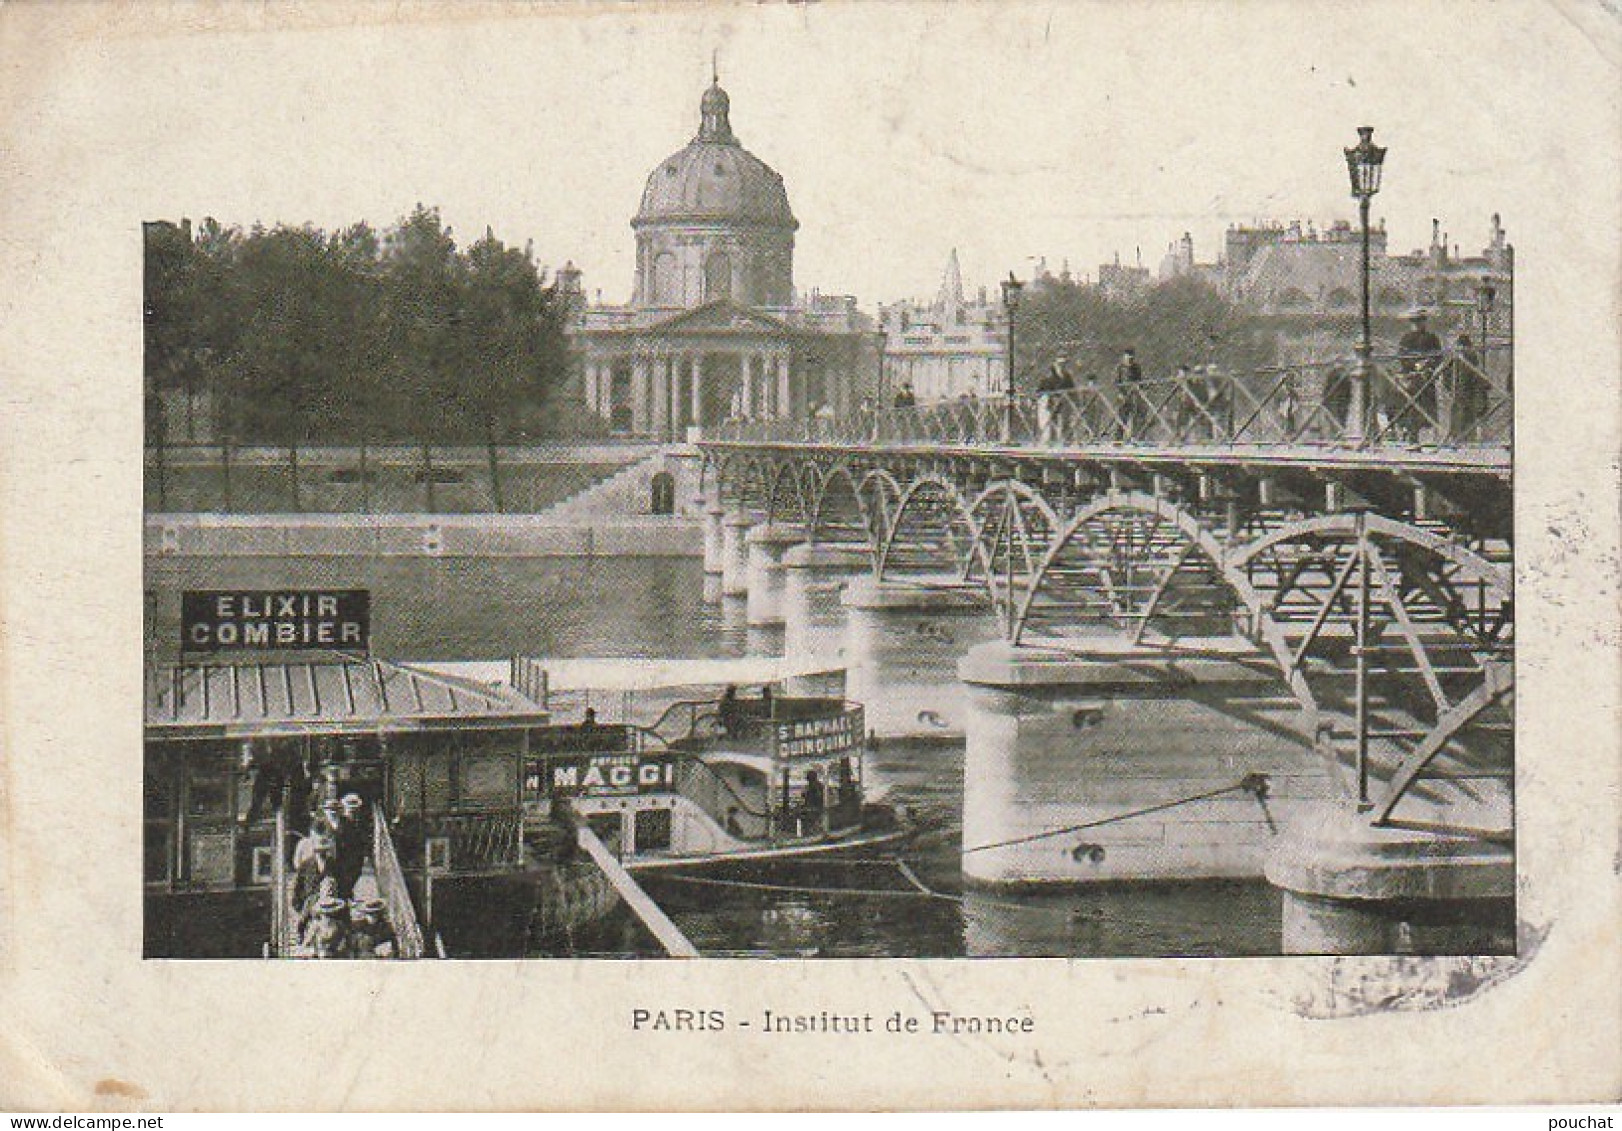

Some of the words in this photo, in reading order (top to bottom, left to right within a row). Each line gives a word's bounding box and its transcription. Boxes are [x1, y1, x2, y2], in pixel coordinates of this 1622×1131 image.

[217, 595, 338, 617] ELIXIR
[191, 622, 361, 643] COMBIER
[554, 764, 673, 786] MAGGI
